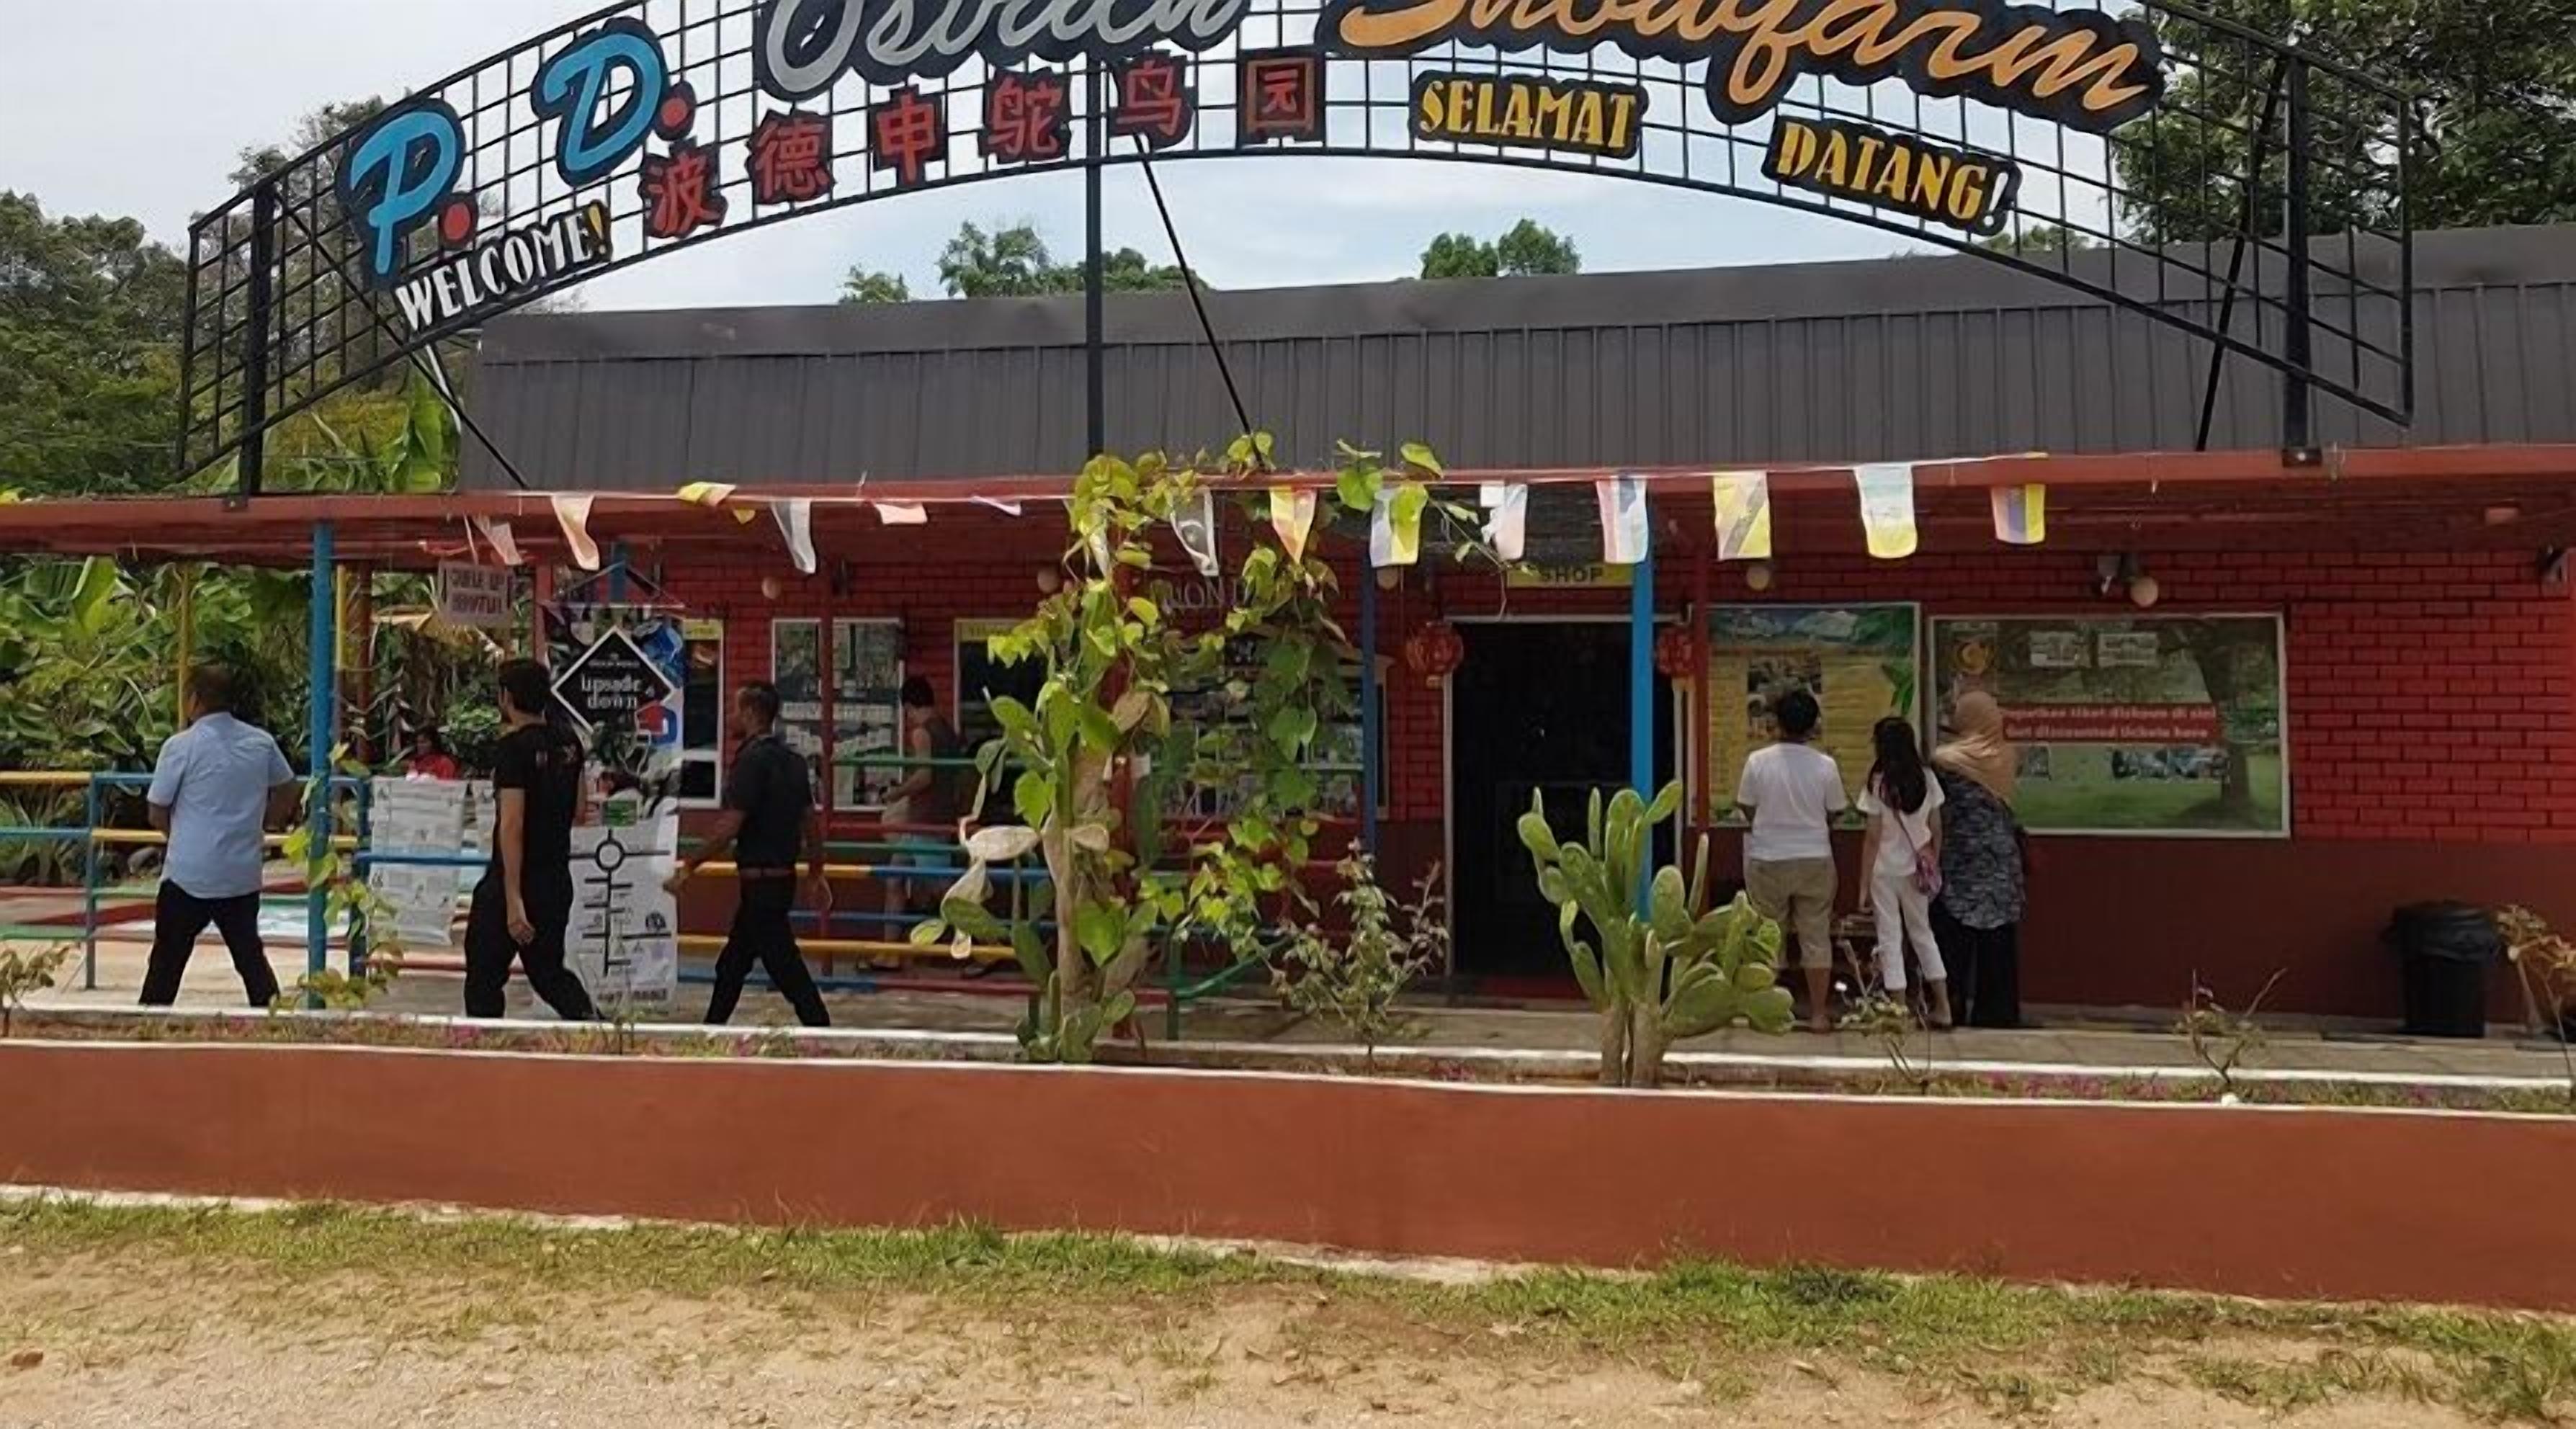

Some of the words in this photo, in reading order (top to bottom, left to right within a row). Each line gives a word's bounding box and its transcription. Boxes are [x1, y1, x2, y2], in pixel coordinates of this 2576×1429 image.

[1340, 0, 2149, 110] owfarm
[649, 57, 1315, 238] 波德申鸵鸟园
[1419, 80, 1637, 148] SELAMAT
[1777, 122, 2009, 227] DATANG!
[395, 202, 608, 331] WELCOME!
